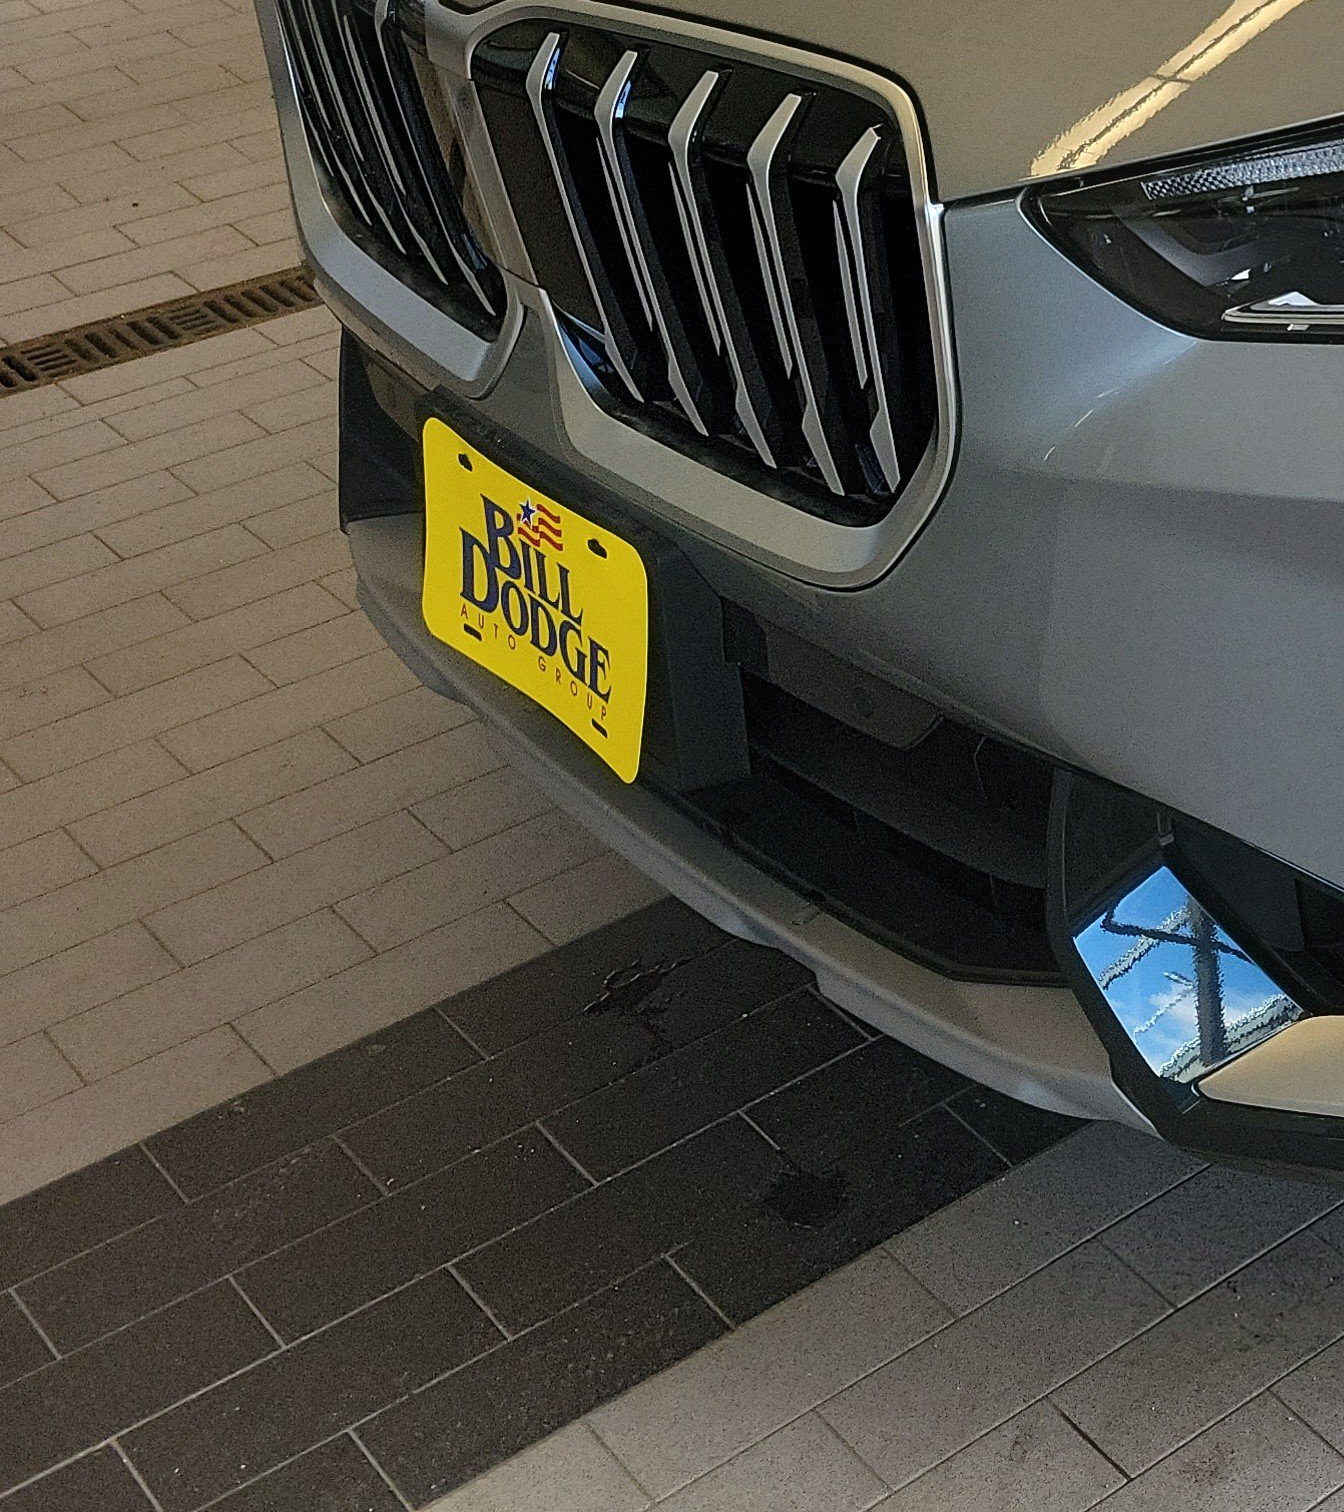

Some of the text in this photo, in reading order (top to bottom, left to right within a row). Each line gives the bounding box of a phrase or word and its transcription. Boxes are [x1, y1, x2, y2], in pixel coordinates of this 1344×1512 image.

[458, 526, 612, 705] DODGE
[480, 493, 583, 628] BILL
[460, 602, 607, 721] AUTO GROUP
